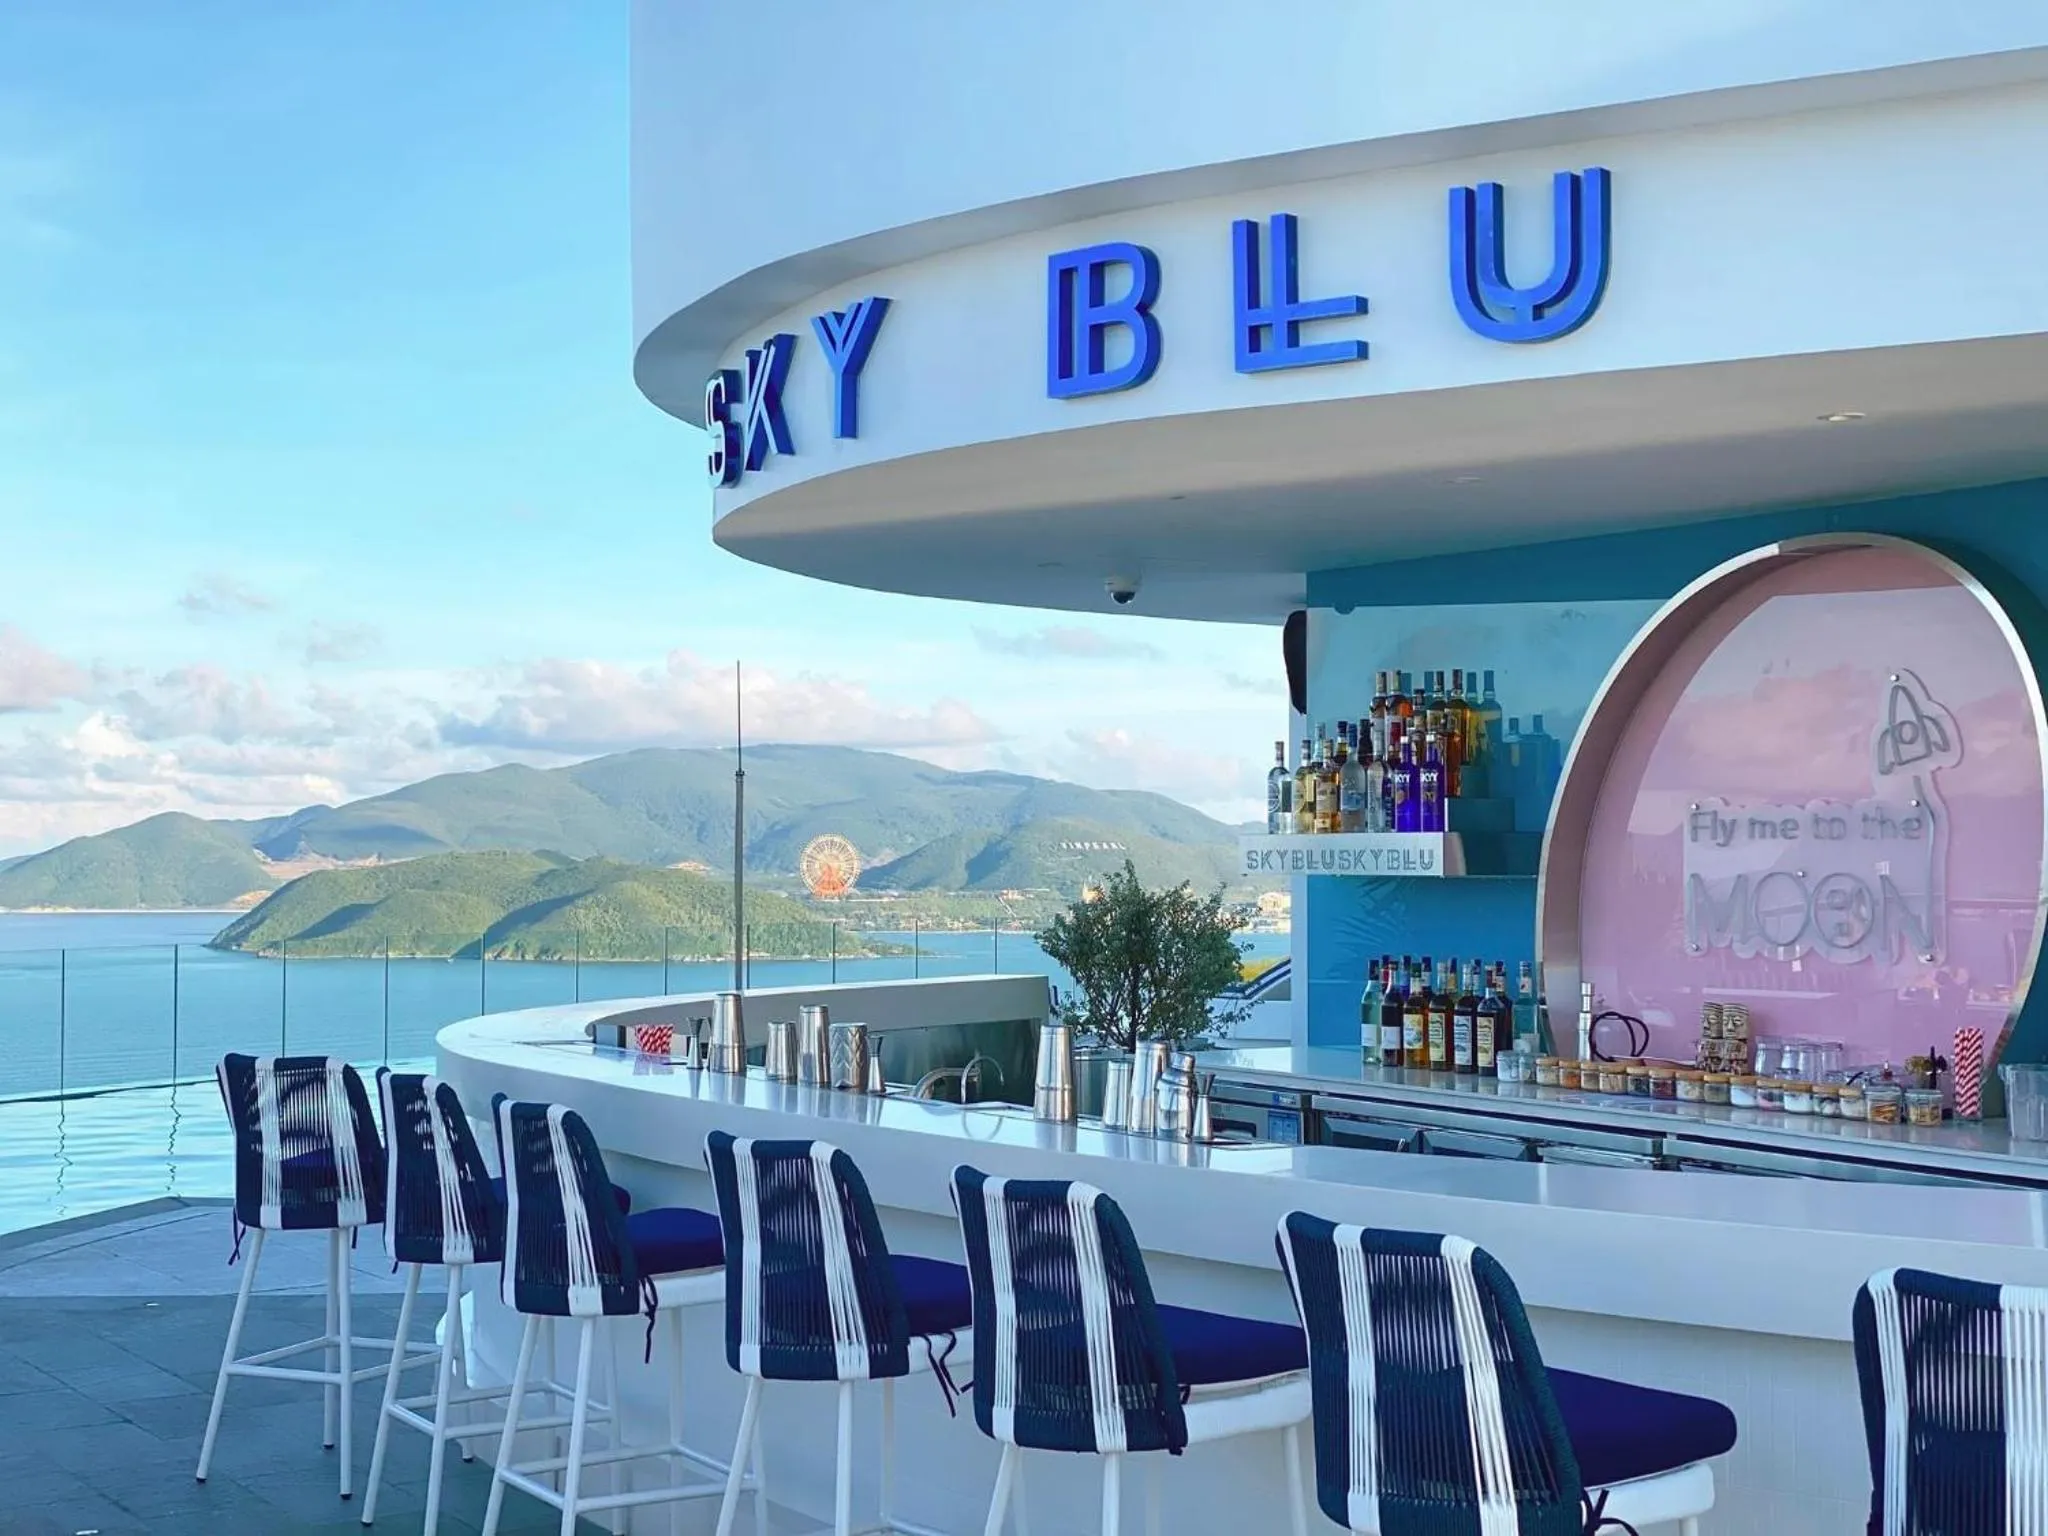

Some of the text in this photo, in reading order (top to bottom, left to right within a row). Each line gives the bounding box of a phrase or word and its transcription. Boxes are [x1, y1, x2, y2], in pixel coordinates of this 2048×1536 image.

[705, 167, 1612, 488] SKY BLU
[1689, 805, 1922, 847] Fly me to the
[1247, 849, 1434, 871] SKYBLUSKYBLU
[1686, 871, 1936, 950] MOON
